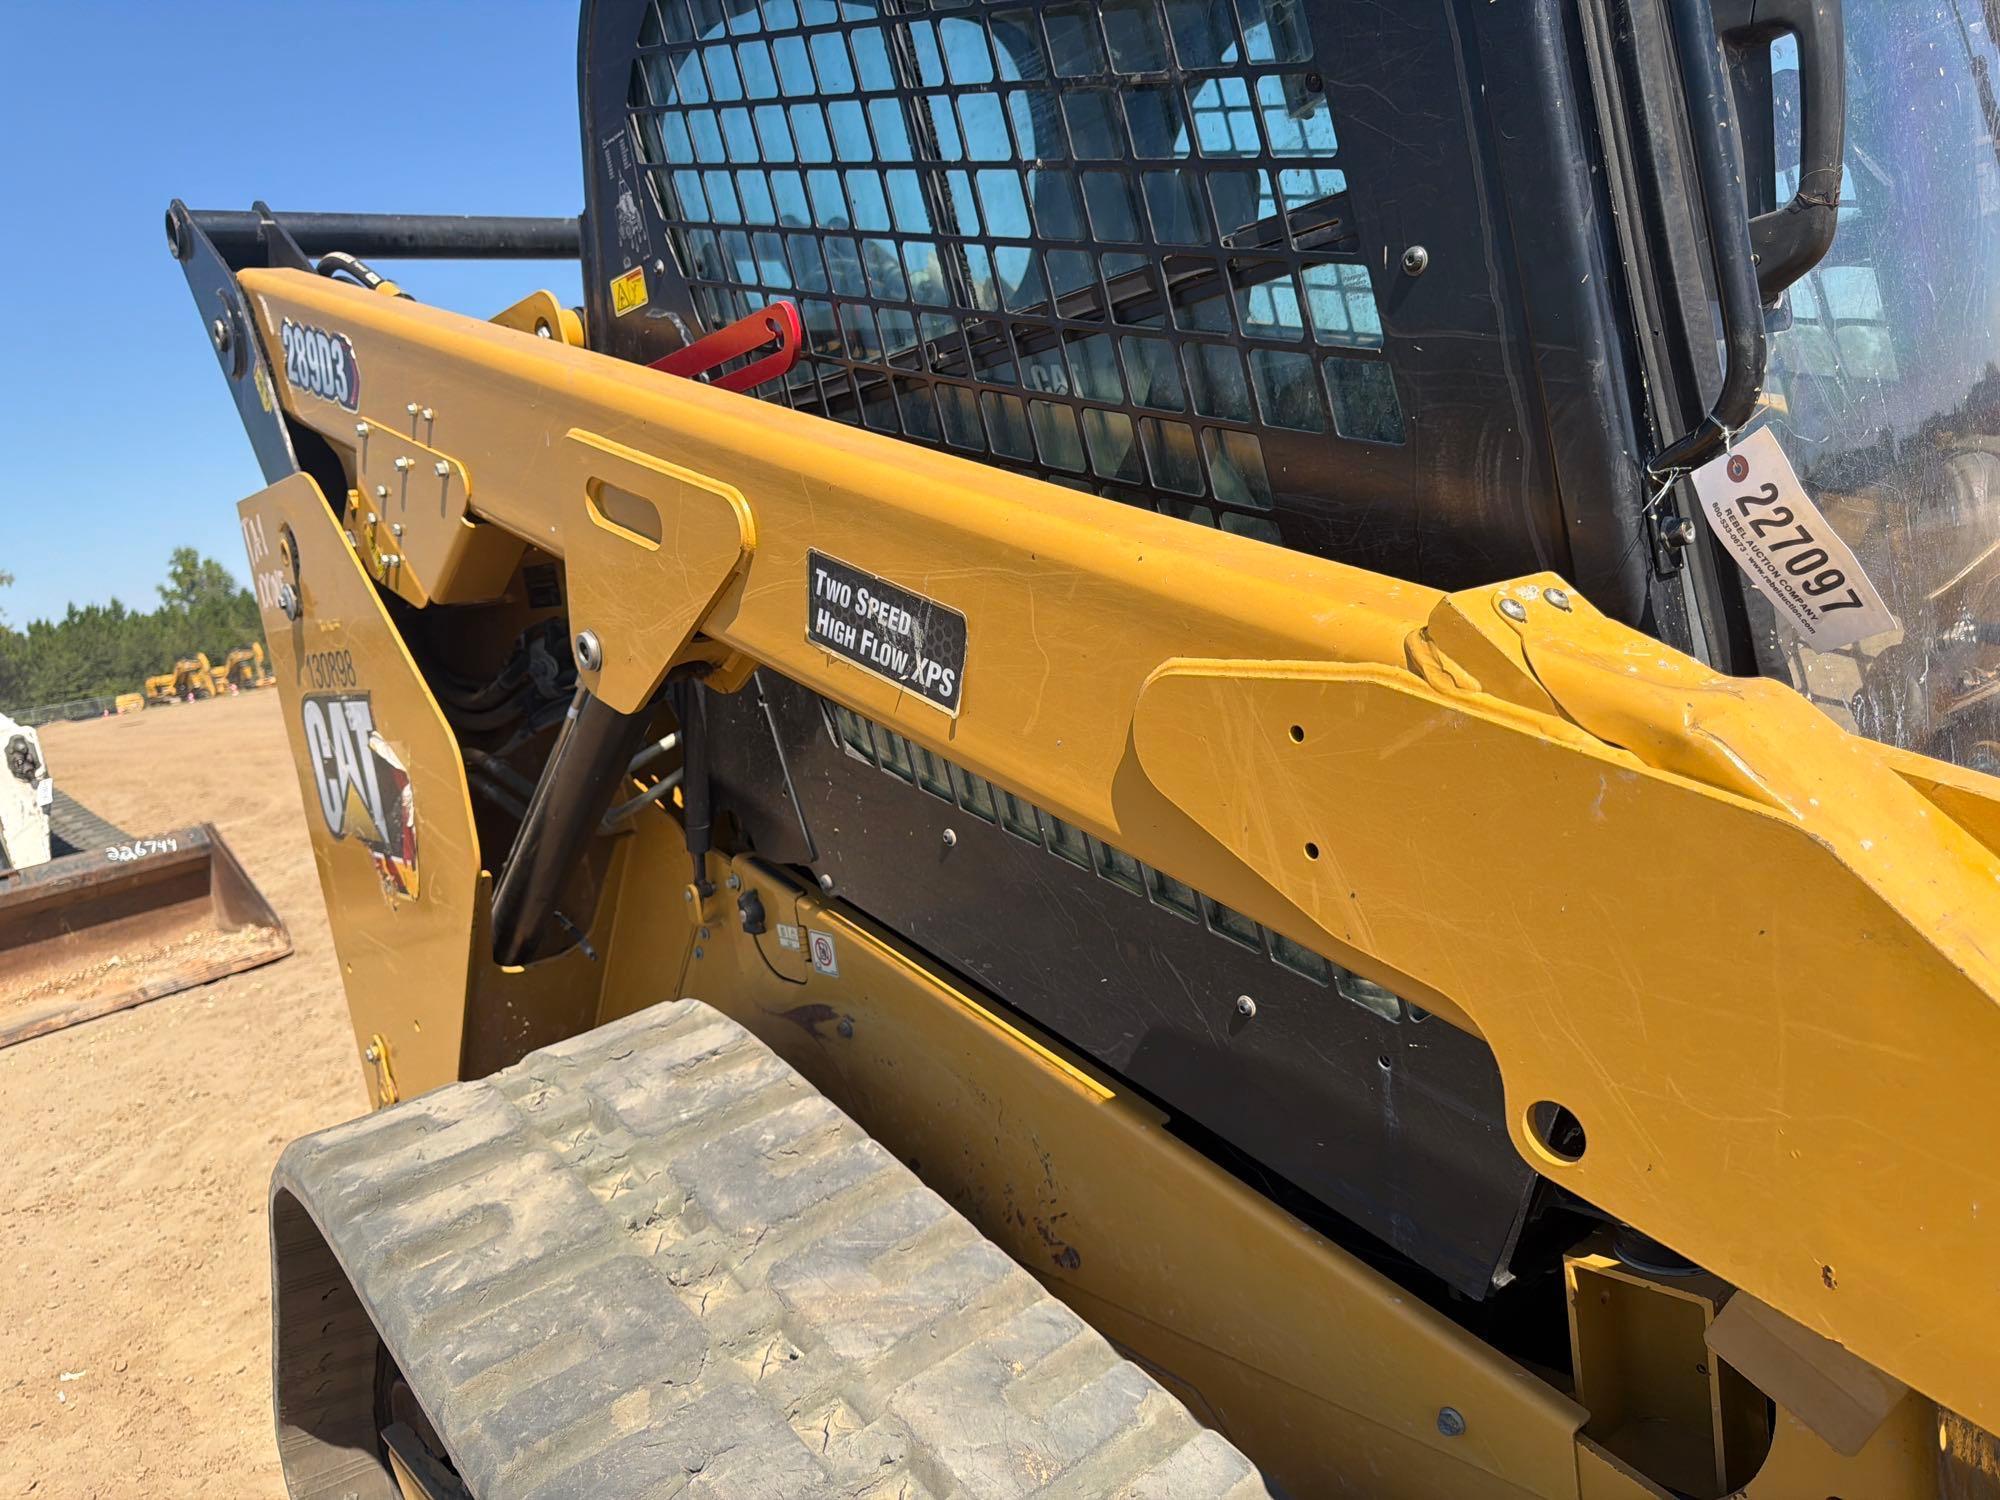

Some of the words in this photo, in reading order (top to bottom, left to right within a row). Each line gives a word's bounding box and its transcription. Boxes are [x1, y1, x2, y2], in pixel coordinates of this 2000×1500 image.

[281, 322, 349, 403] 289D3
[1712, 502, 1747, 552] 800-533-0673
[1748, 556, 1816, 635] www.rebelauction.com
[1725, 508, 1747, 539] REBEL
[1746, 540, 1781, 579] AUCTION
[1779, 579, 1819, 621] COMPANY
[1735, 482, 1864, 613] 227097
[307, 649, 357, 689] 130898
[911, 656, 956, 697] XPS
[304, 699, 390, 846] CAT
[105, 838, 178, 861] 226744
